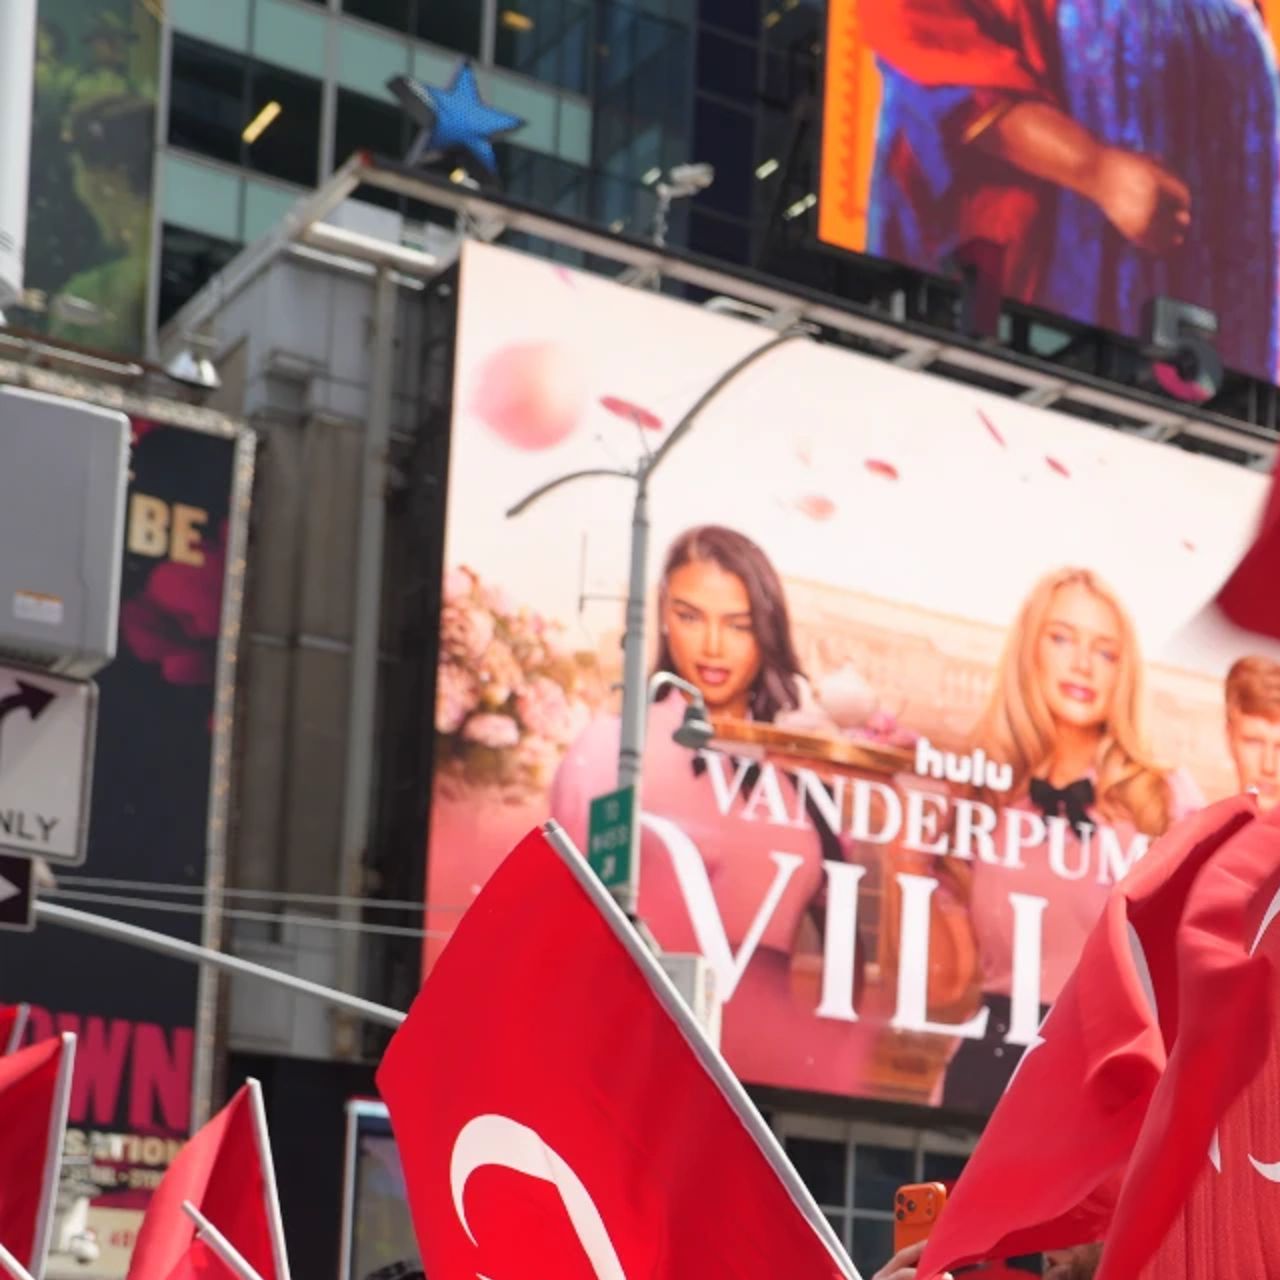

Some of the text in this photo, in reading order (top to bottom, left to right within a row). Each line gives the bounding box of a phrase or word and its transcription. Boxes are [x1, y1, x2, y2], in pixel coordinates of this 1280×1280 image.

[915, 737, 1013, 791] hulu
[0, 809, 60, 843] NLY
[703, 749, 1152, 886] VANDERPUM
